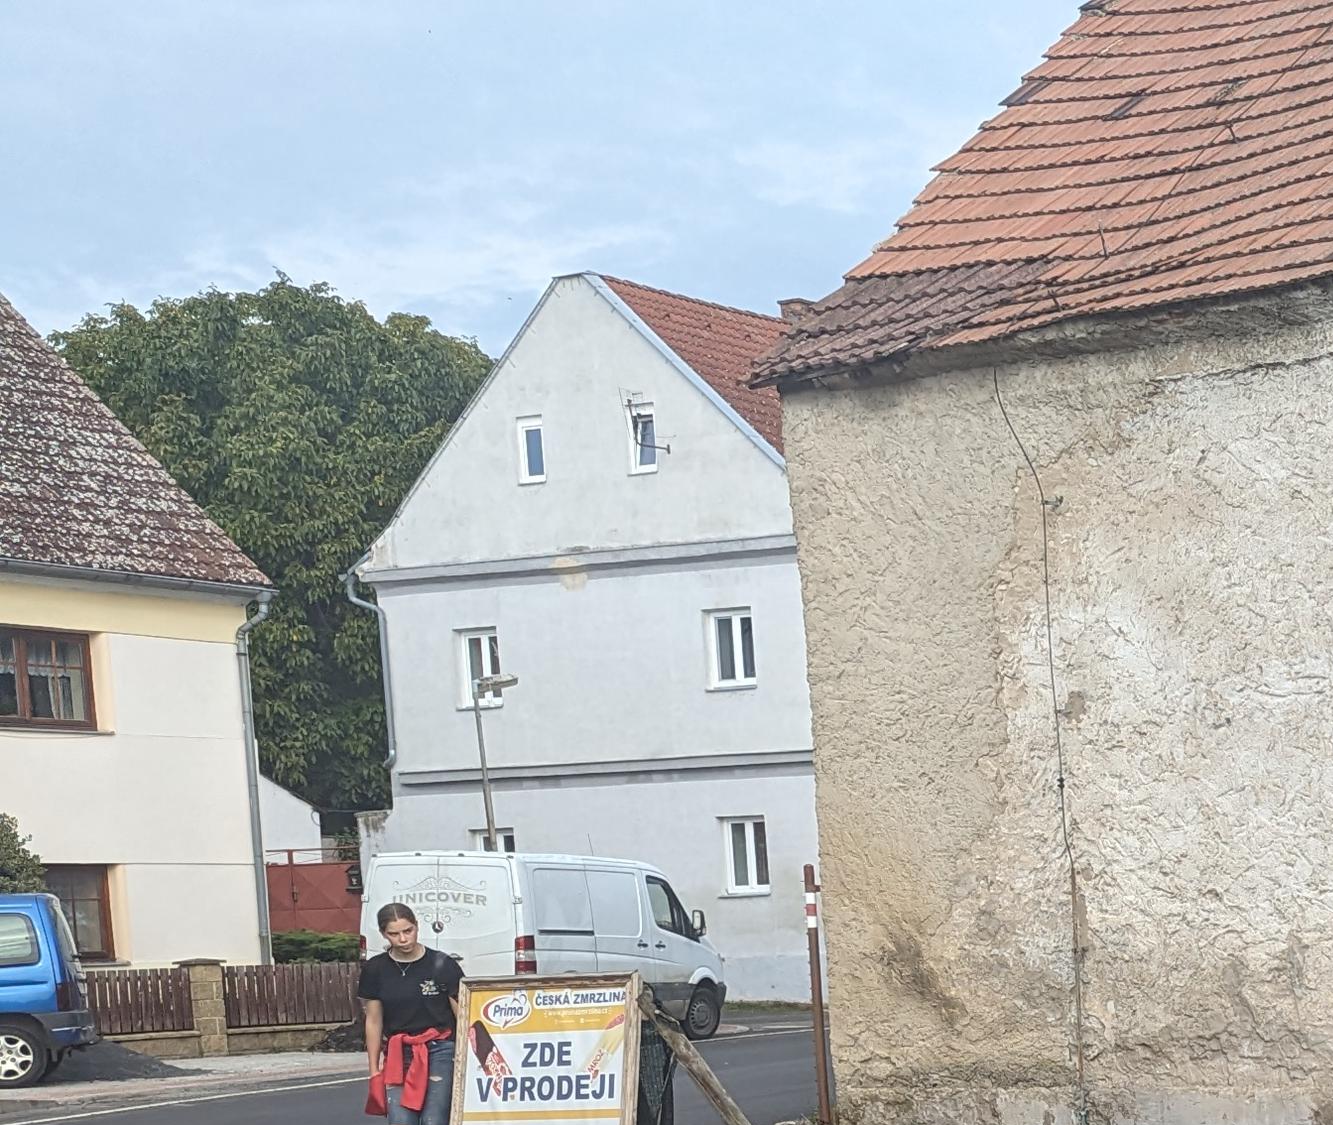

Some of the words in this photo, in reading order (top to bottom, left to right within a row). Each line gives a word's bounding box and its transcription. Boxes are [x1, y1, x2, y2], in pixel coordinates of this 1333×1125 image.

[392, 891, 488, 906] UNICOVER
[535, 991, 571, 1007] ČESKÁ
[573, 991, 627, 1005] ZMRZLINA
[492, 1003, 524, 1019] Prima
[521, 1041, 573, 1068] ZDE
[476, 1077, 494, 1103] V
[502, 1073, 616, 1102] PRODEJI
